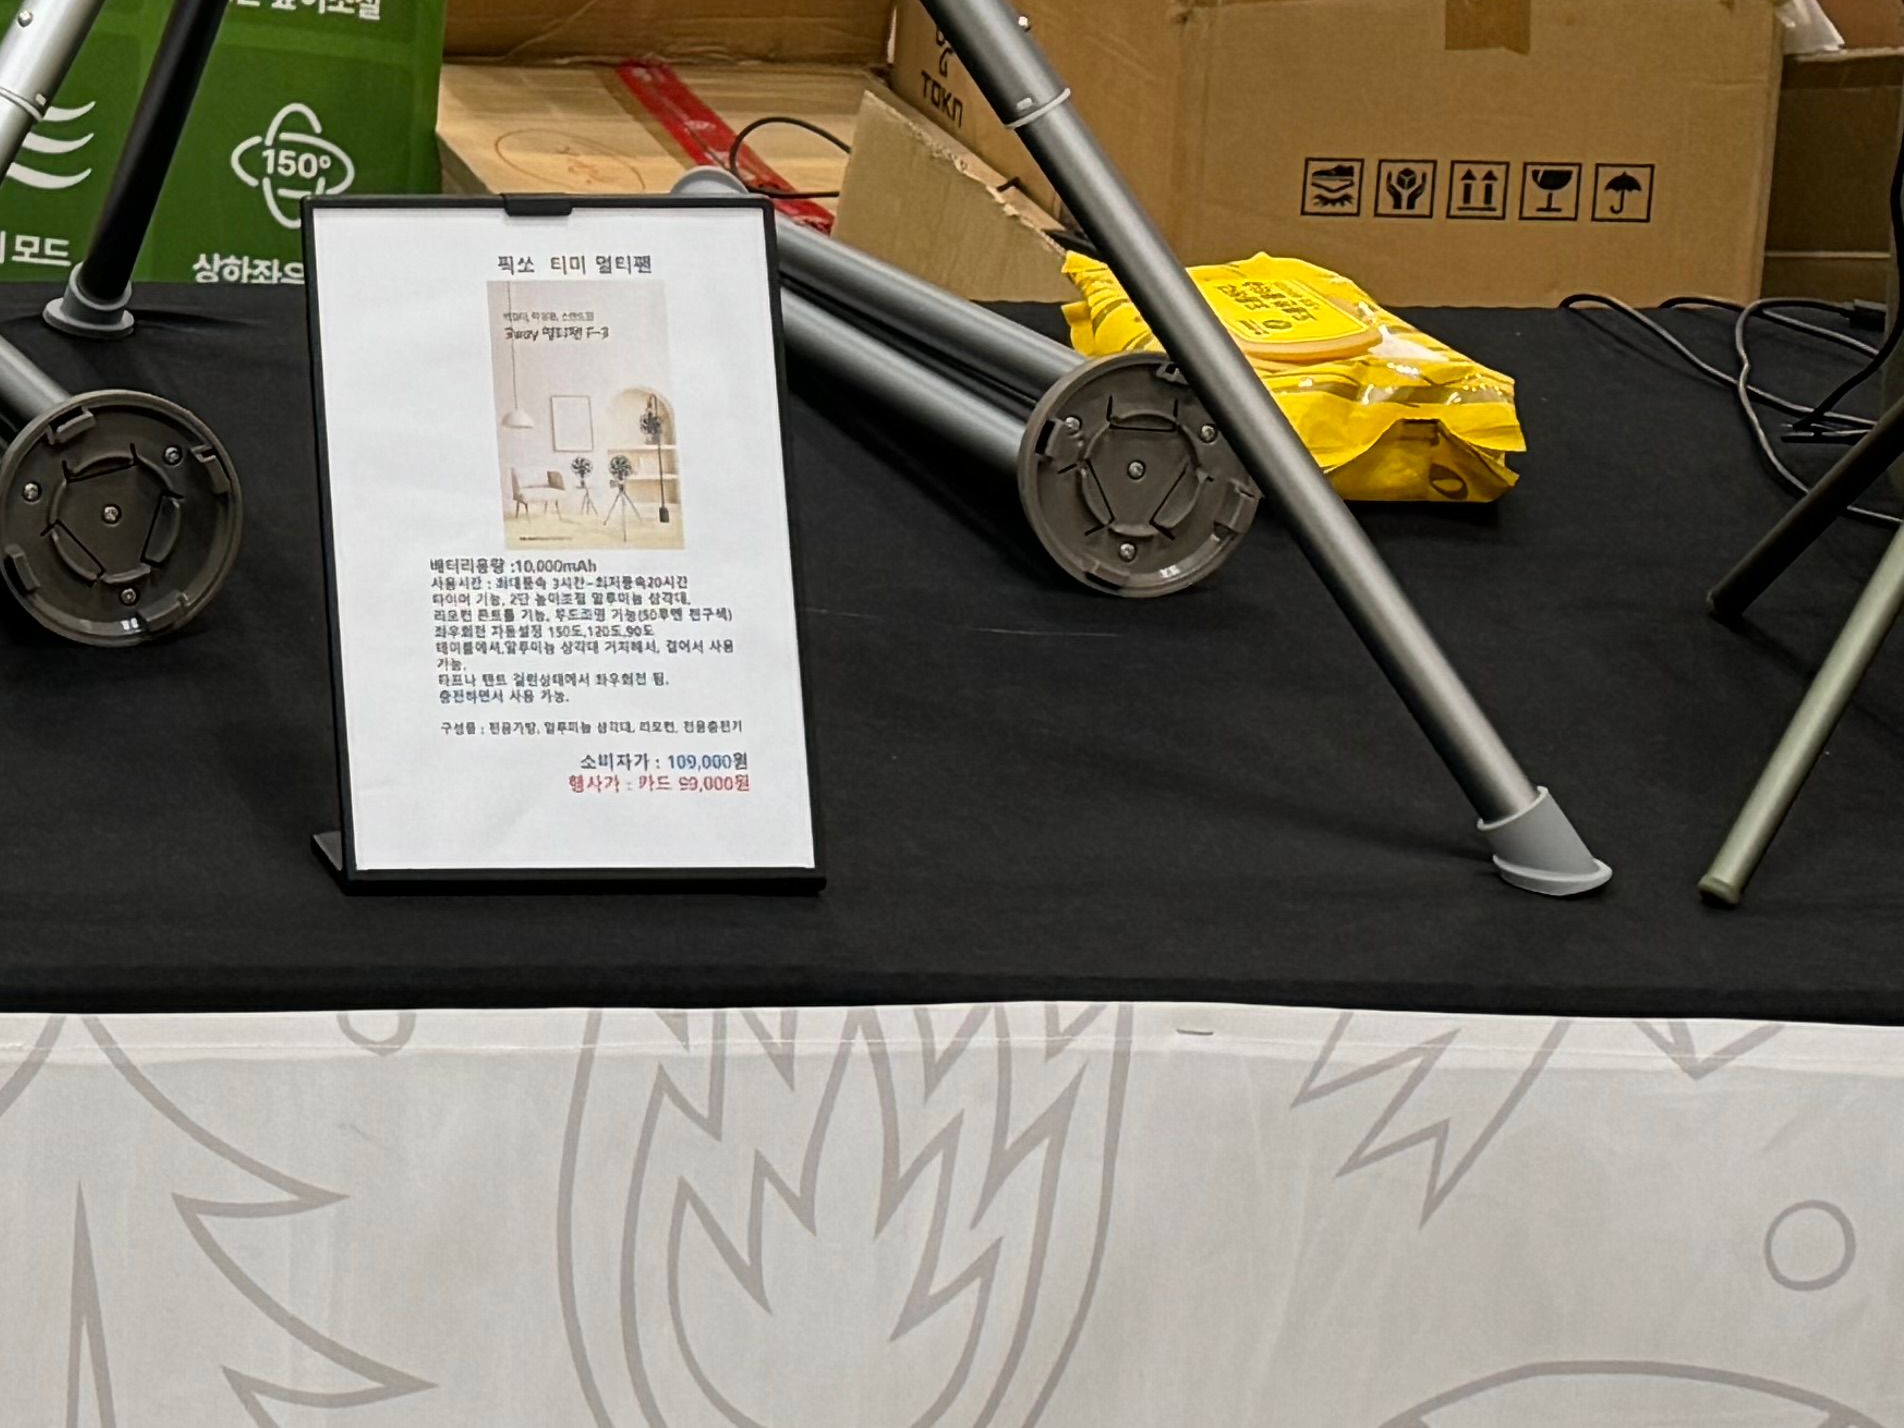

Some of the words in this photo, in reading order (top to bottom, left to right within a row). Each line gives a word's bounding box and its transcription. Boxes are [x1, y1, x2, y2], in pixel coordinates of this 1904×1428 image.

[11, 234, 71, 267] 모드
[497, 255, 535, 275] 픽쏘
[550, 255, 586, 275] 티미
[430, 558, 505, 575] 배터리용량
[431, 576, 482, 591] 사용시간
[432, 593, 471, 607] 타이머
[592, 592, 643, 606] 알루미늄
[434, 609, 473, 623] 리모컨
[560, 641, 599, 655] 삼각대
[709, 639, 734, 653] 사용
[439, 689, 504, 704] 충전하면서
[509, 689, 535, 704] 사용
[580, 753, 650, 771] 소비자가
[667, 752, 749, 771] 109,000원
[569, 774, 620, 793] 행사가
[639, 774, 671, 792] 카드
